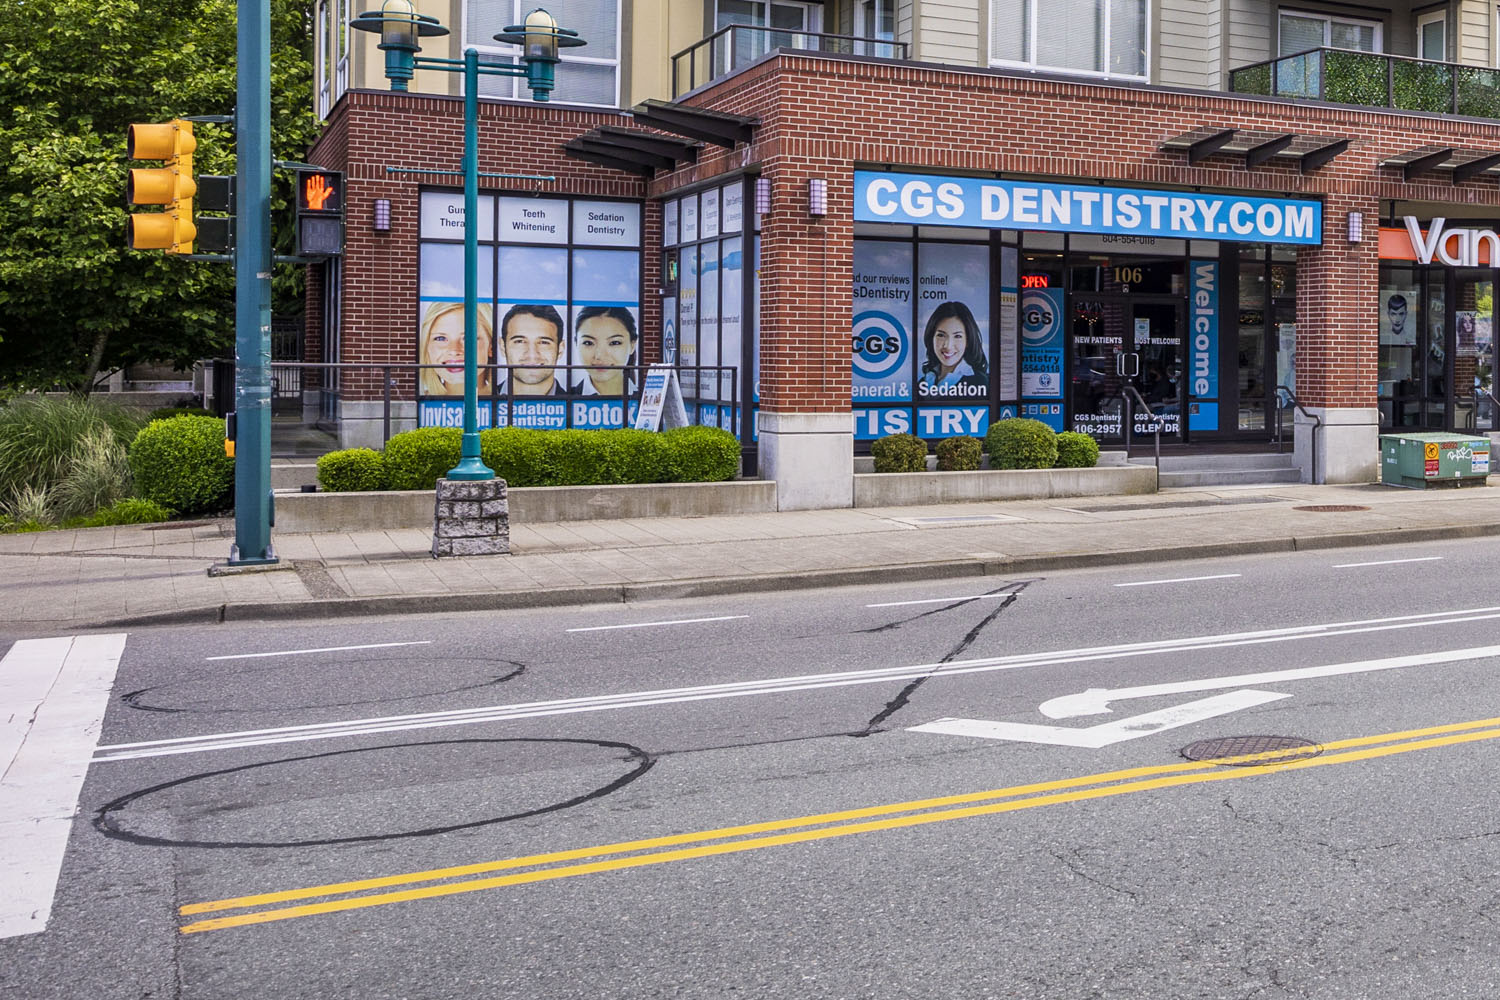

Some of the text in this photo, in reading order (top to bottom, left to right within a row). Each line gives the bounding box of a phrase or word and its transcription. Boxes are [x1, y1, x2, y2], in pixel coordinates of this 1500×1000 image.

[522, 209, 546, 219] Teeth
[866, 178, 1314, 239] CGS DENTISTRY.COM
[588, 212, 625, 222] Sedation
[440, 218, 465, 228] Thera
[512, 221, 556, 233] Whitening
[587, 225, 626, 236] Dentistry
[863, 275, 877, 284] our
[879, 275, 910, 285] reviews
[919, 275, 948, 286] online!
[1114, 267, 1143, 283] 106
[1021, 275, 1049, 288] OPEN
[1027, 311, 1052, 325] GS
[1195, 264, 1214, 396] Welcome
[852, 336, 899, 354] CGS
[1074, 336, 1090, 344] NEW
[1091, 336, 1123, 345] PATIENTS
[1134, 337, 1150, 345] MOST
[1022, 354, 1060, 364] ntistry
[1021, 365, 1060, 373] -554-0118
[852, 381, 987, 397] eneral & Sedation
[498, 403, 564, 416] Sedation
[573, 402, 637, 427] Botox
[498, 415, 565, 428] Dentistry
[1091, 414, 1122, 423] Dentistry
[1134, 413, 1149, 421] CGS
[1074, 424, 1122, 434] 106-2957
[1134, 424, 1180, 433] GLEN DR
